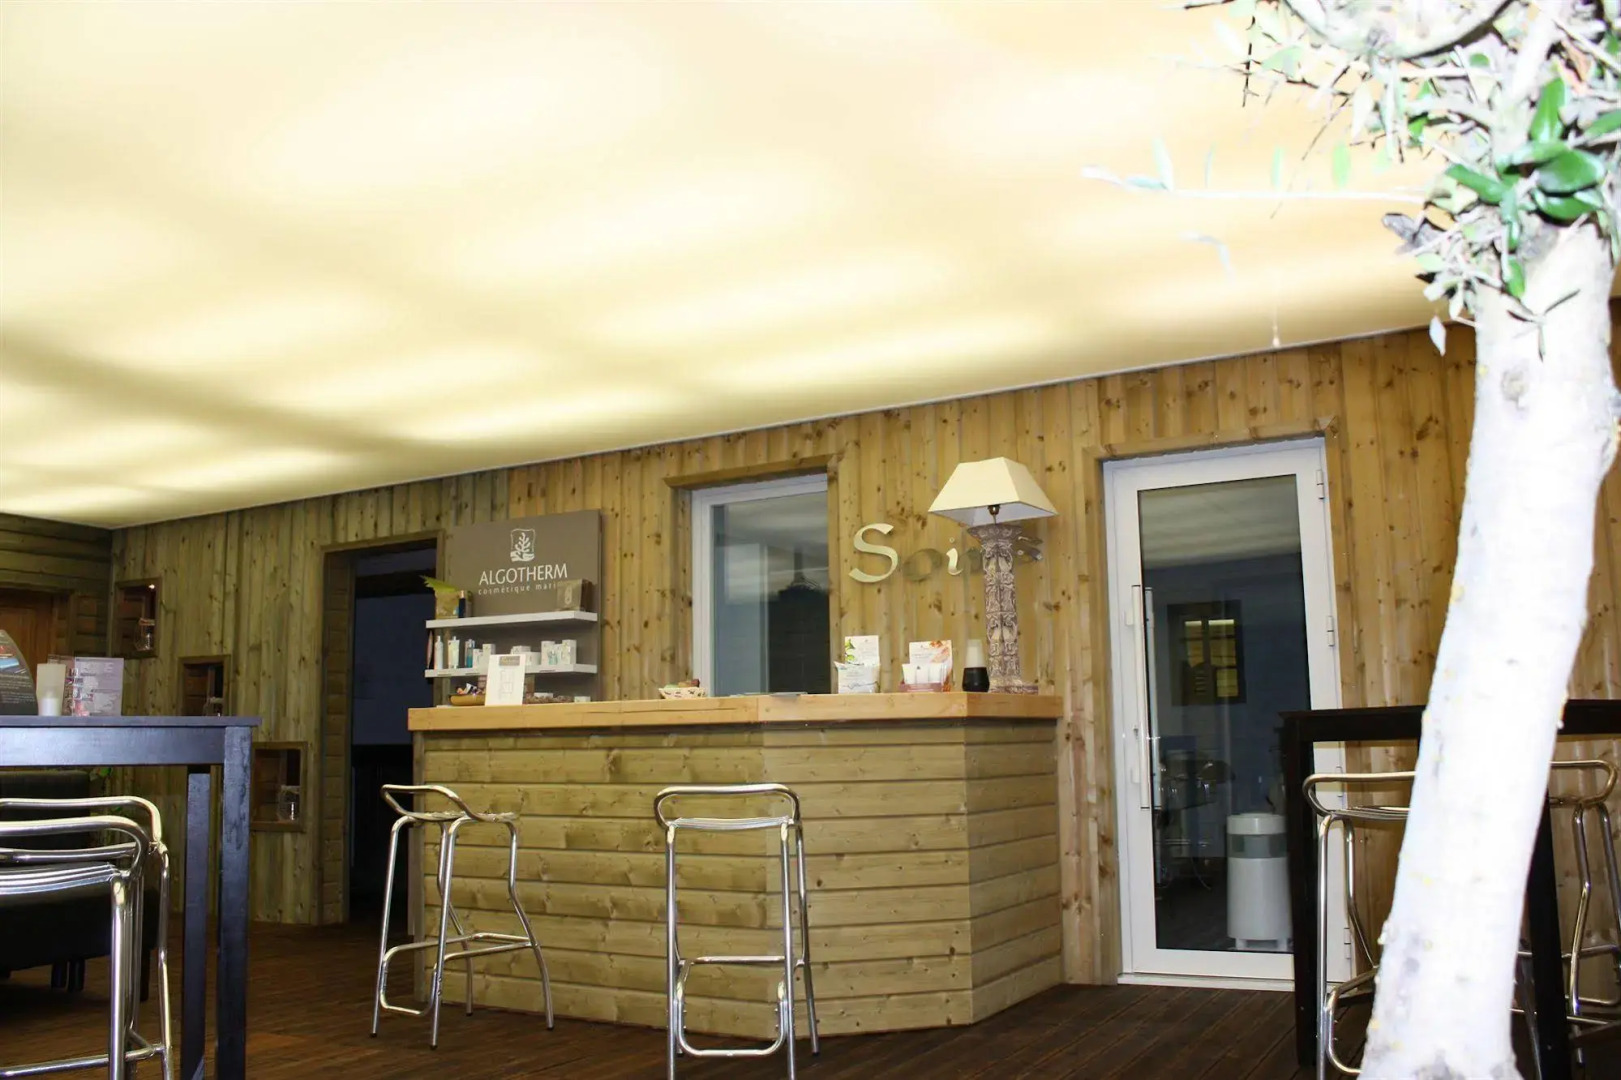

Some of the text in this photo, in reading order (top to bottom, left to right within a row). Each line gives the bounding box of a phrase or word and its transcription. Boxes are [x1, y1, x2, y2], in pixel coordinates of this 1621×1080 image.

[478, 563, 568, 585] ALGOTHERM
[478, 582, 558, 595] cosmétique mari
